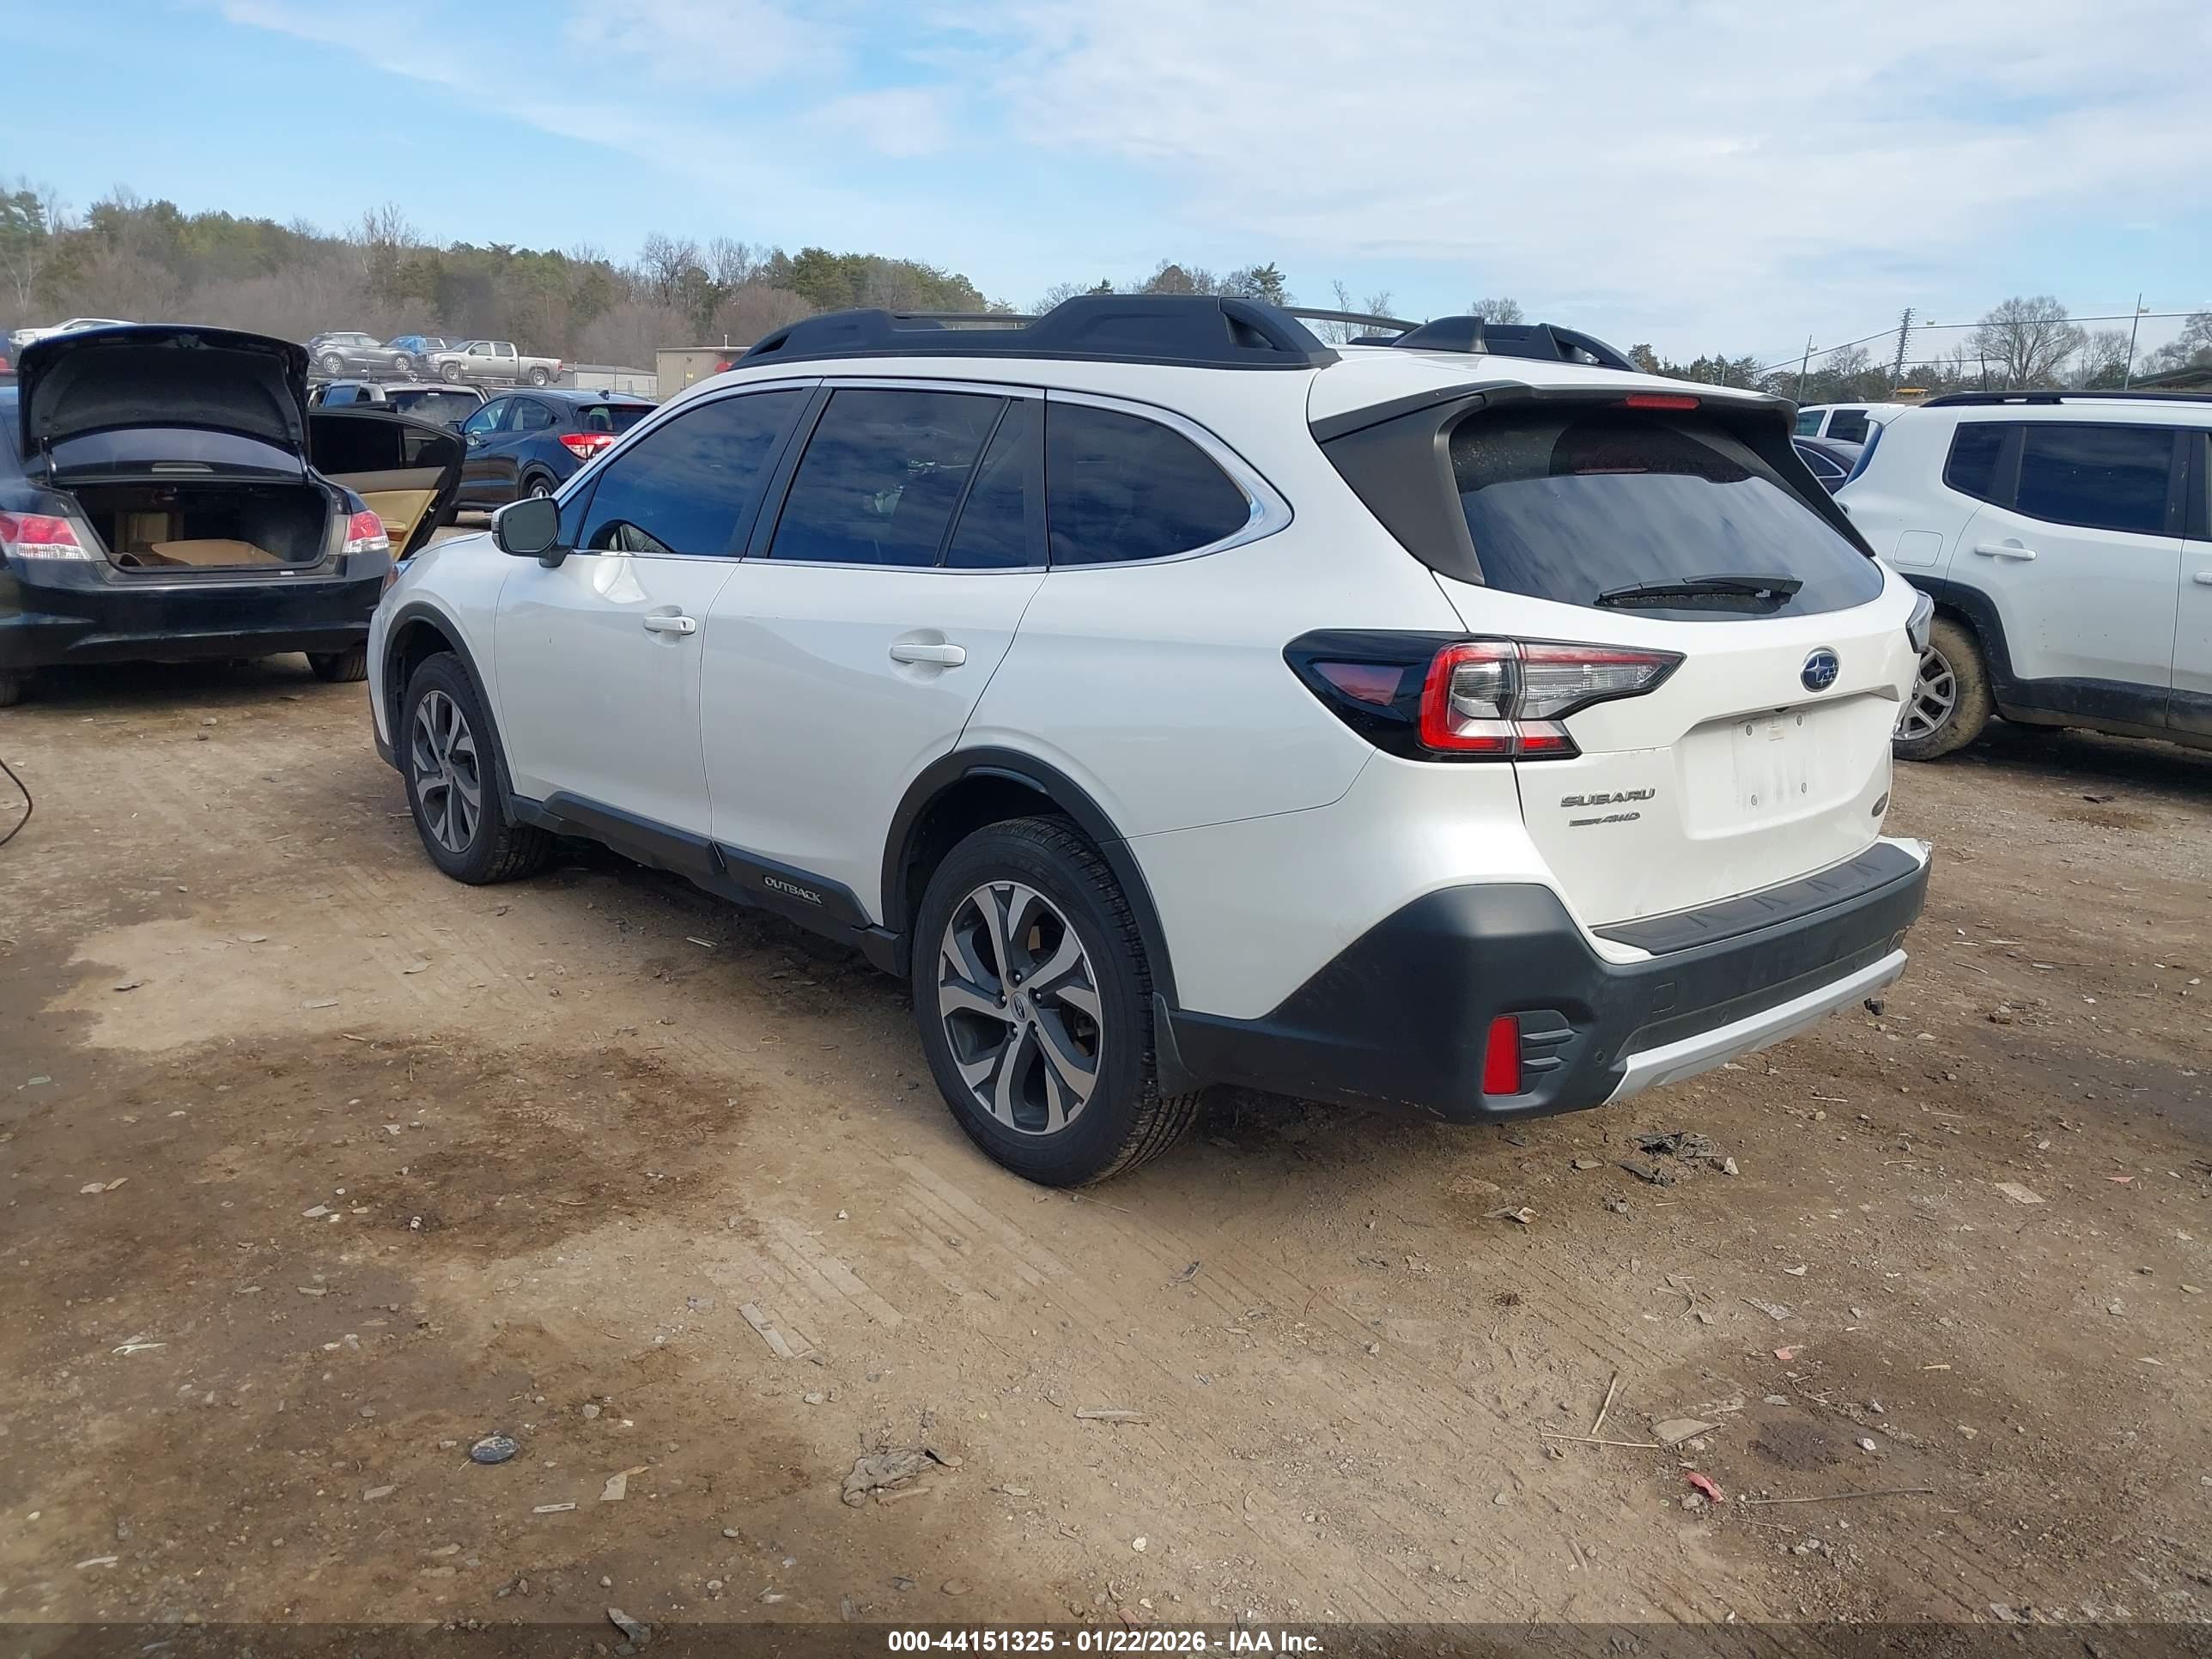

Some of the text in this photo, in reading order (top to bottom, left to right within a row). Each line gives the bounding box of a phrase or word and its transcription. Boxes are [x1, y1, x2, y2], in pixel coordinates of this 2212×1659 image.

[1560, 787, 1656, 808] SUBARU
[1601, 811, 1641, 823] AWD
[763, 876, 823, 904] OUTBACK
